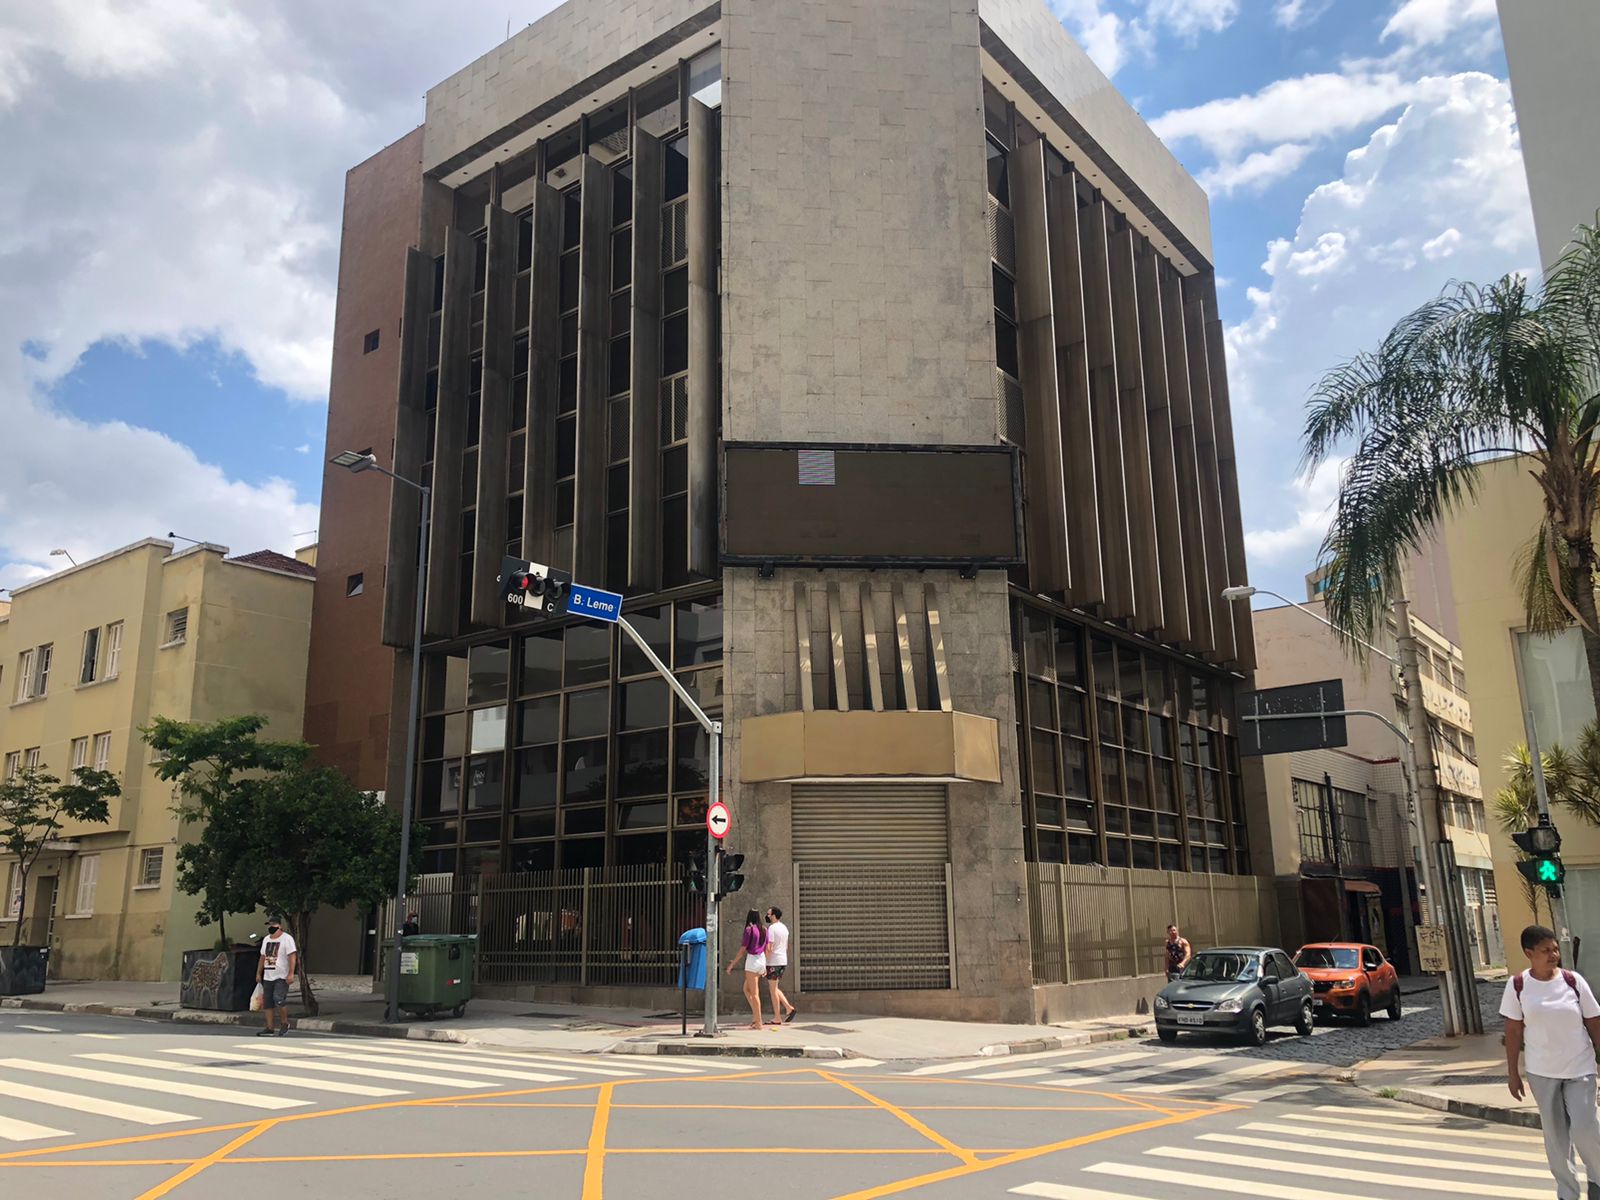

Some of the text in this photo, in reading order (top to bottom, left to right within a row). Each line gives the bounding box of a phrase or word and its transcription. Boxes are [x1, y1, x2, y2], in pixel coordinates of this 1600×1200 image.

[507, 592, 554, 612] 600 C
[573, 594, 614, 612] B. Leme
